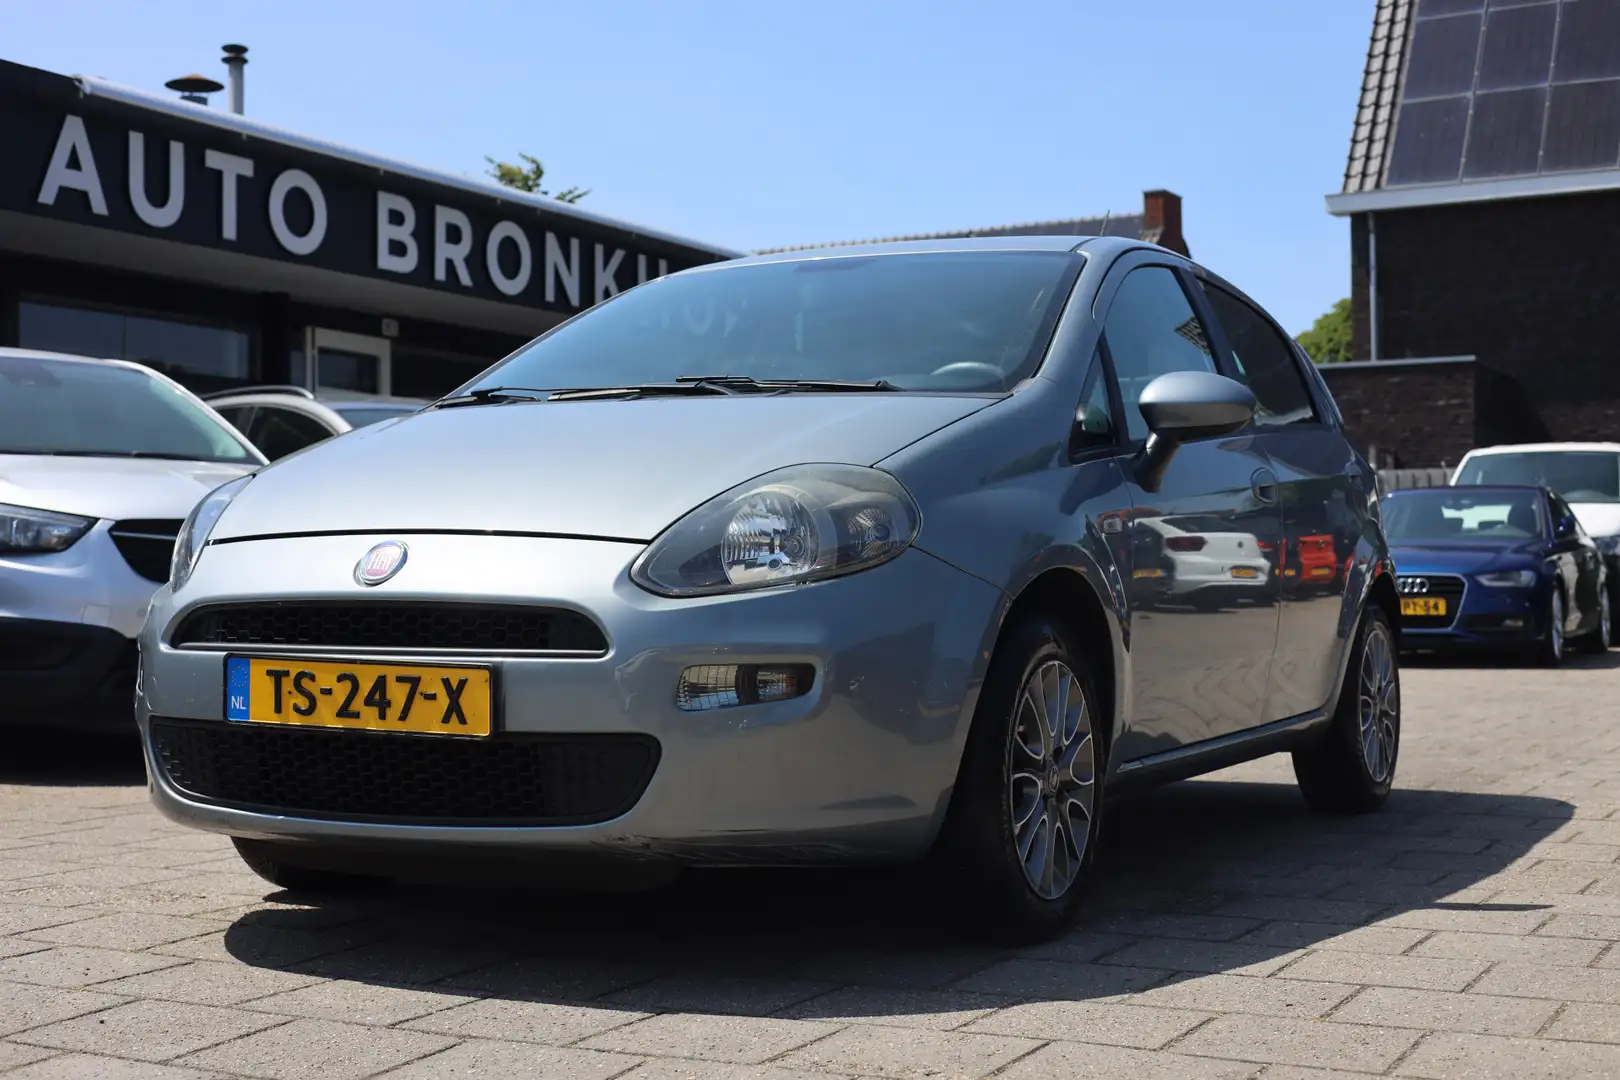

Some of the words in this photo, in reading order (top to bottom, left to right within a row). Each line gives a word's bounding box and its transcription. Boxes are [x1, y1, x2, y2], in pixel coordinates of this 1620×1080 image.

[37, 114, 328, 256] AUTO
[230, 696, 247, 709] NL
[266, 669, 469, 725] TS-247-X
